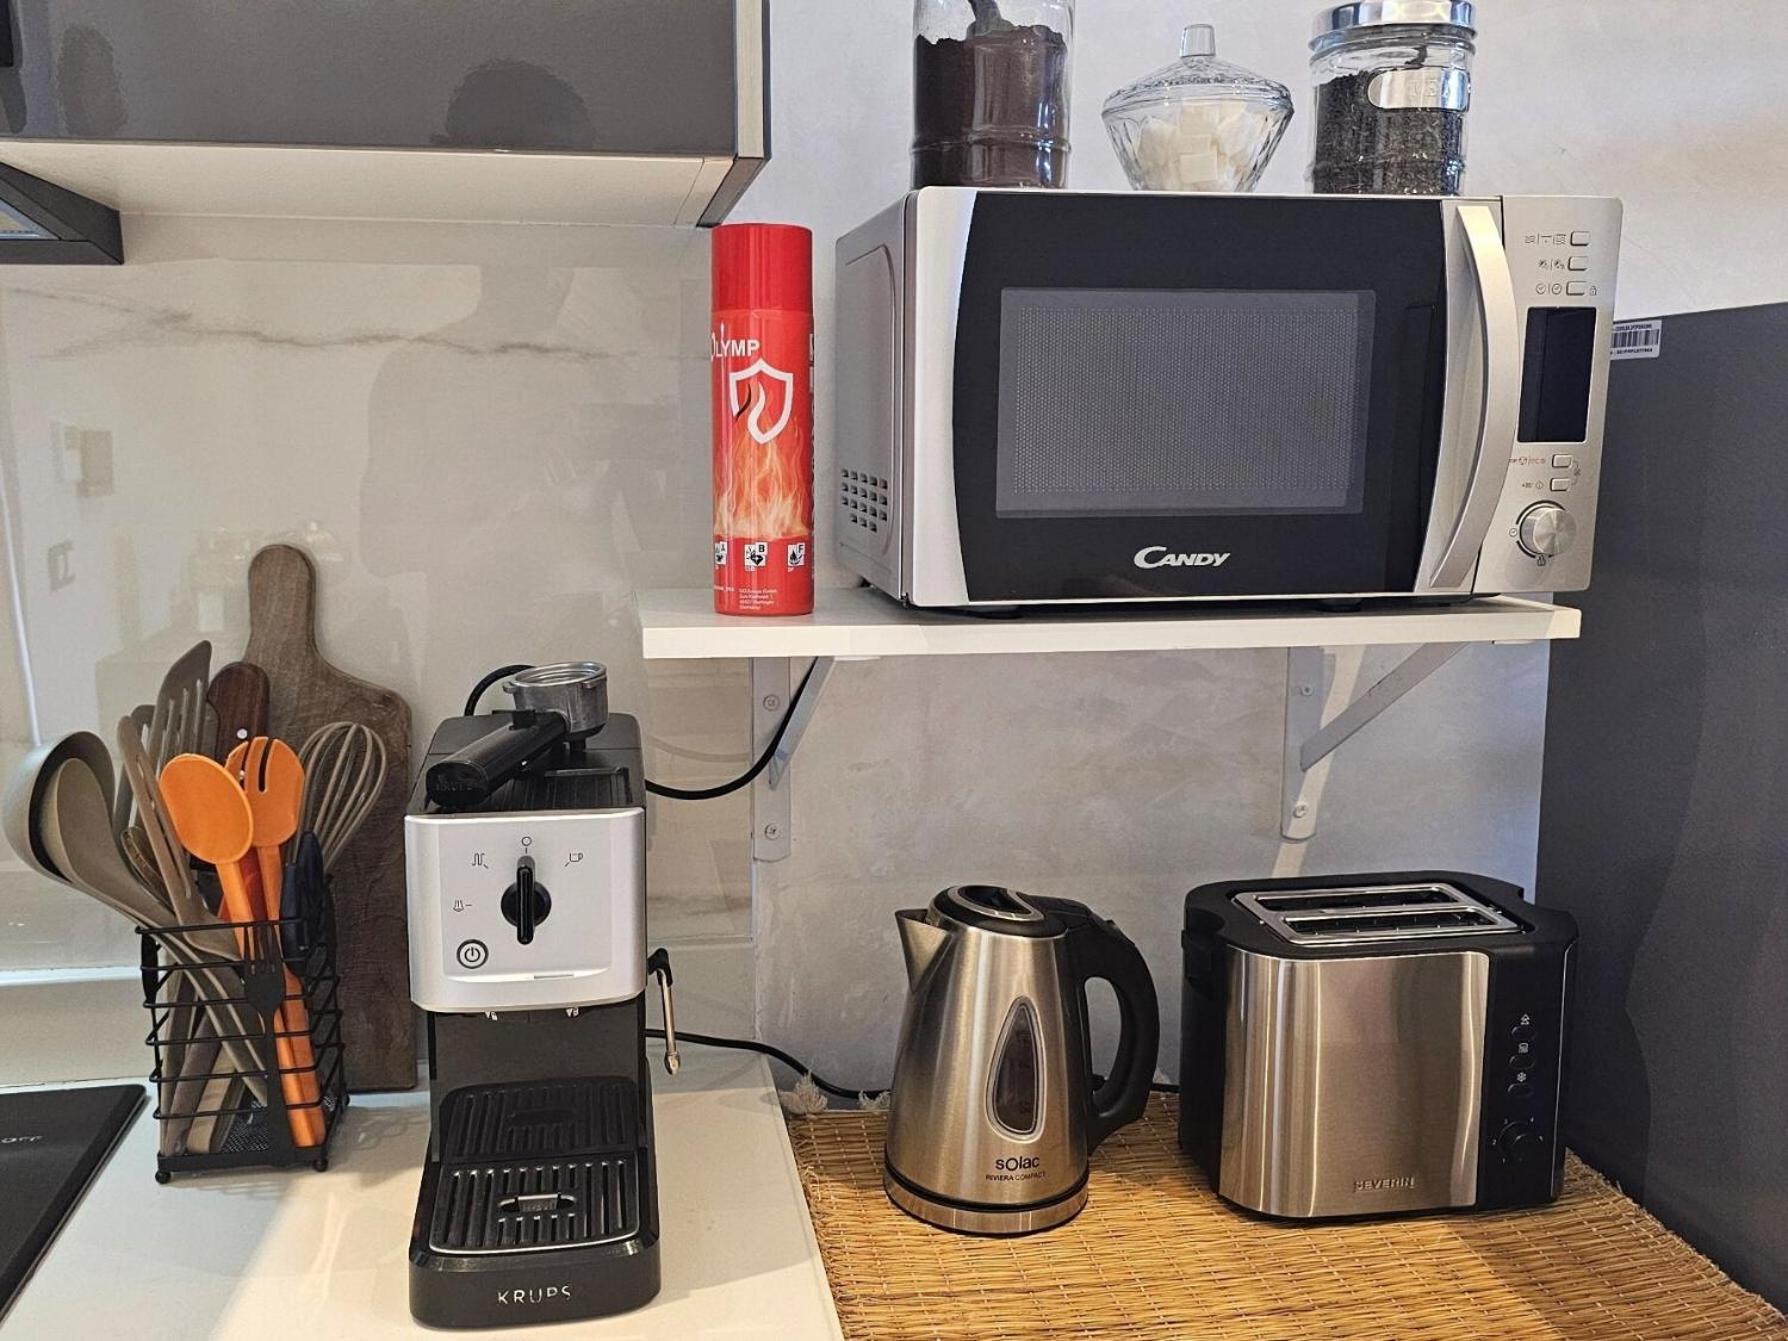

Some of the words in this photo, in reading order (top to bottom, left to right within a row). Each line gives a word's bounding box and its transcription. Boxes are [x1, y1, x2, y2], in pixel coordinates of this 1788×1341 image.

[1133, 545, 1231, 569] CANDY
[1015, 1171, 1046, 1181] COMPACT
[498, 1285, 571, 1304] KRUPS
